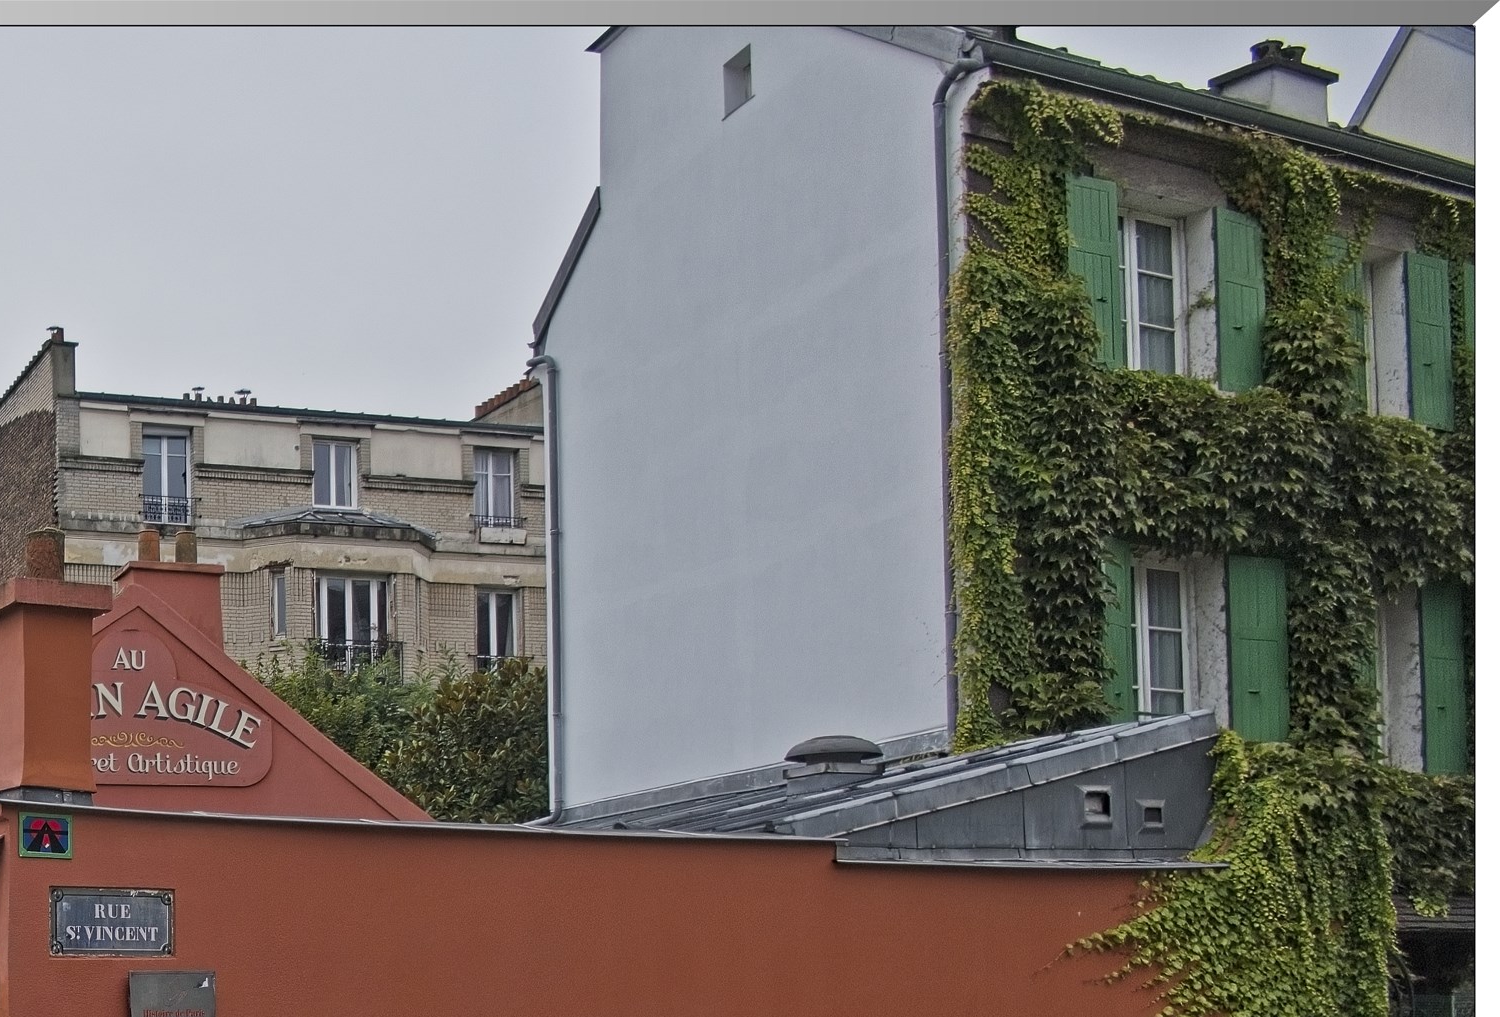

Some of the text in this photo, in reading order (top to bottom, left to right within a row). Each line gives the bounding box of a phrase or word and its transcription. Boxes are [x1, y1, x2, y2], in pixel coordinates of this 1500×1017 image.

[112, 646, 147, 671] AU
[91, 681, 262, 750] N AGILE
[127, 751, 241, 781] Artistique
[94, 903, 131, 919] RUE
[84, 925, 159, 942] VINCENT
